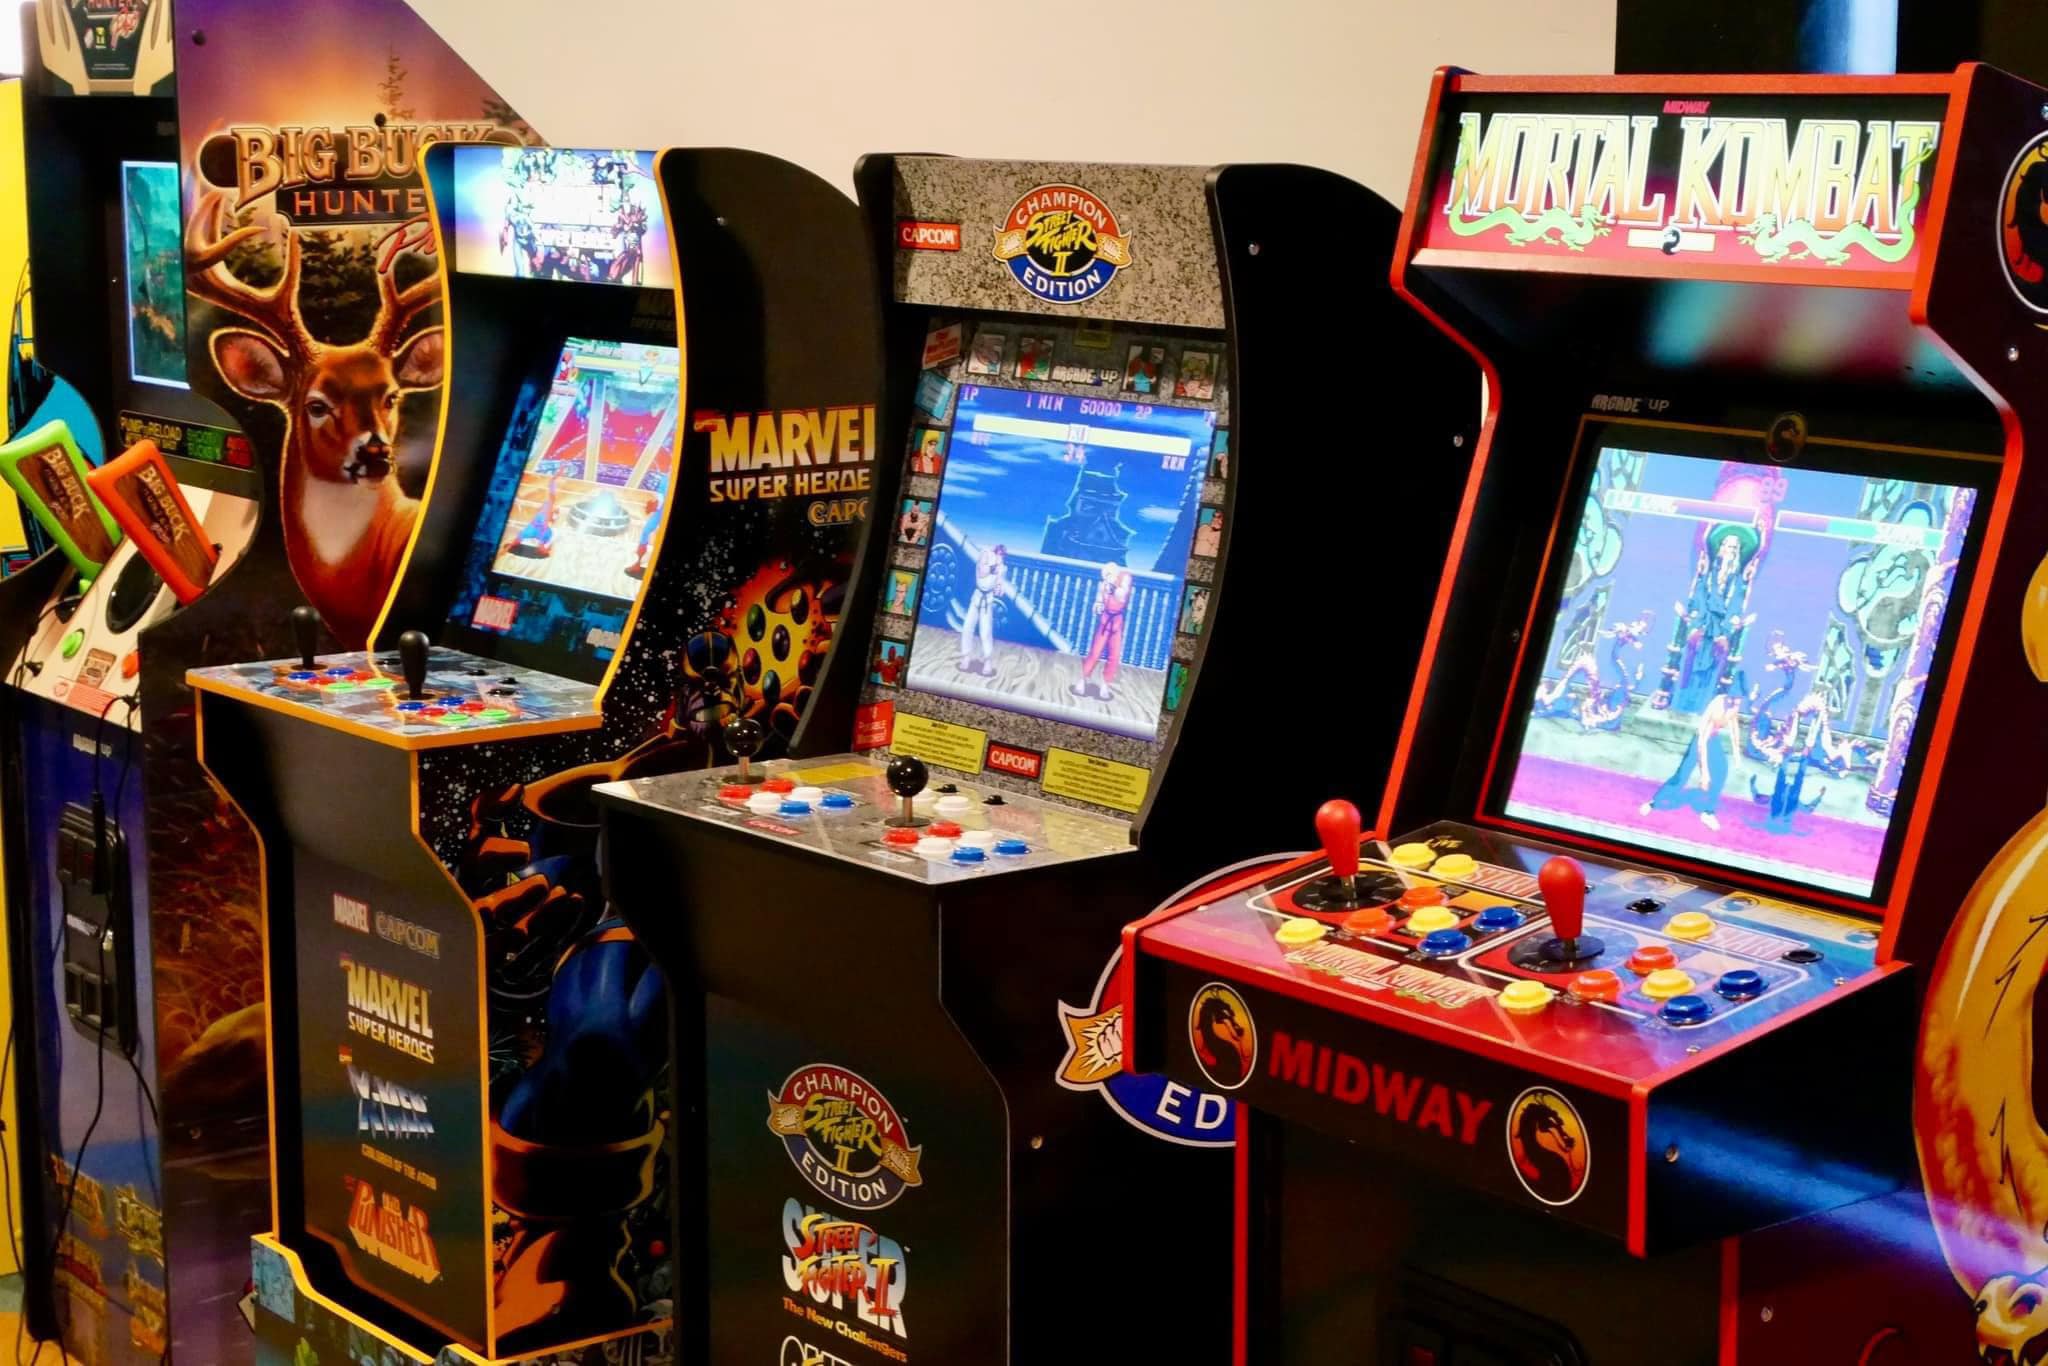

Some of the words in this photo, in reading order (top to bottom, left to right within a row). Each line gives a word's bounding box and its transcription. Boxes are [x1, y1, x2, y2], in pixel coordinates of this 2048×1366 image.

[1663, 101, 1710, 114] MIDWAY
[231, 127, 338, 213] BIG
[1444, 112, 1666, 227] MORTAL
[1669, 117, 1941, 240] KOMBAT
[1015, 191, 1107, 229] CHAMPION
[1026, 211, 1074, 249] STREET
[902, 224, 957, 246] CAPCOM
[1033, 219, 1097, 255] FIGHTER
[1023, 267, 1101, 297] EDITION
[135, 464, 166, 496] BIG
[160, 495, 191, 542] BUCK
[709, 474, 788, 503] SUPER
[991, 749, 1037, 773] CAPCOM
[375, 910, 442, 960] CAPCOM
[340, 957, 434, 1039] MARVEL
[348, 1011, 387, 1044] SUPER
[387, 1027, 435, 1065] HEROES
[793, 1073, 894, 1134] CHAMPION
[803, 1092, 856, 1130] STREET
[1156, 1081, 1228, 1130] ED
[1268, 1031, 1492, 1146] MIDWAY
[815, 1116, 883, 1156] FIGHTER
[801, 1151, 887, 1202] EDITION
[348, 1179, 441, 1284] PUNISHER
[792, 1213, 877, 1259] STREET
[797, 1254, 872, 1308] FIGHTER
[782, 1296, 805, 1320] The
[806, 1306, 835, 1331] New
[834, 1320, 908, 1363] Challengers
